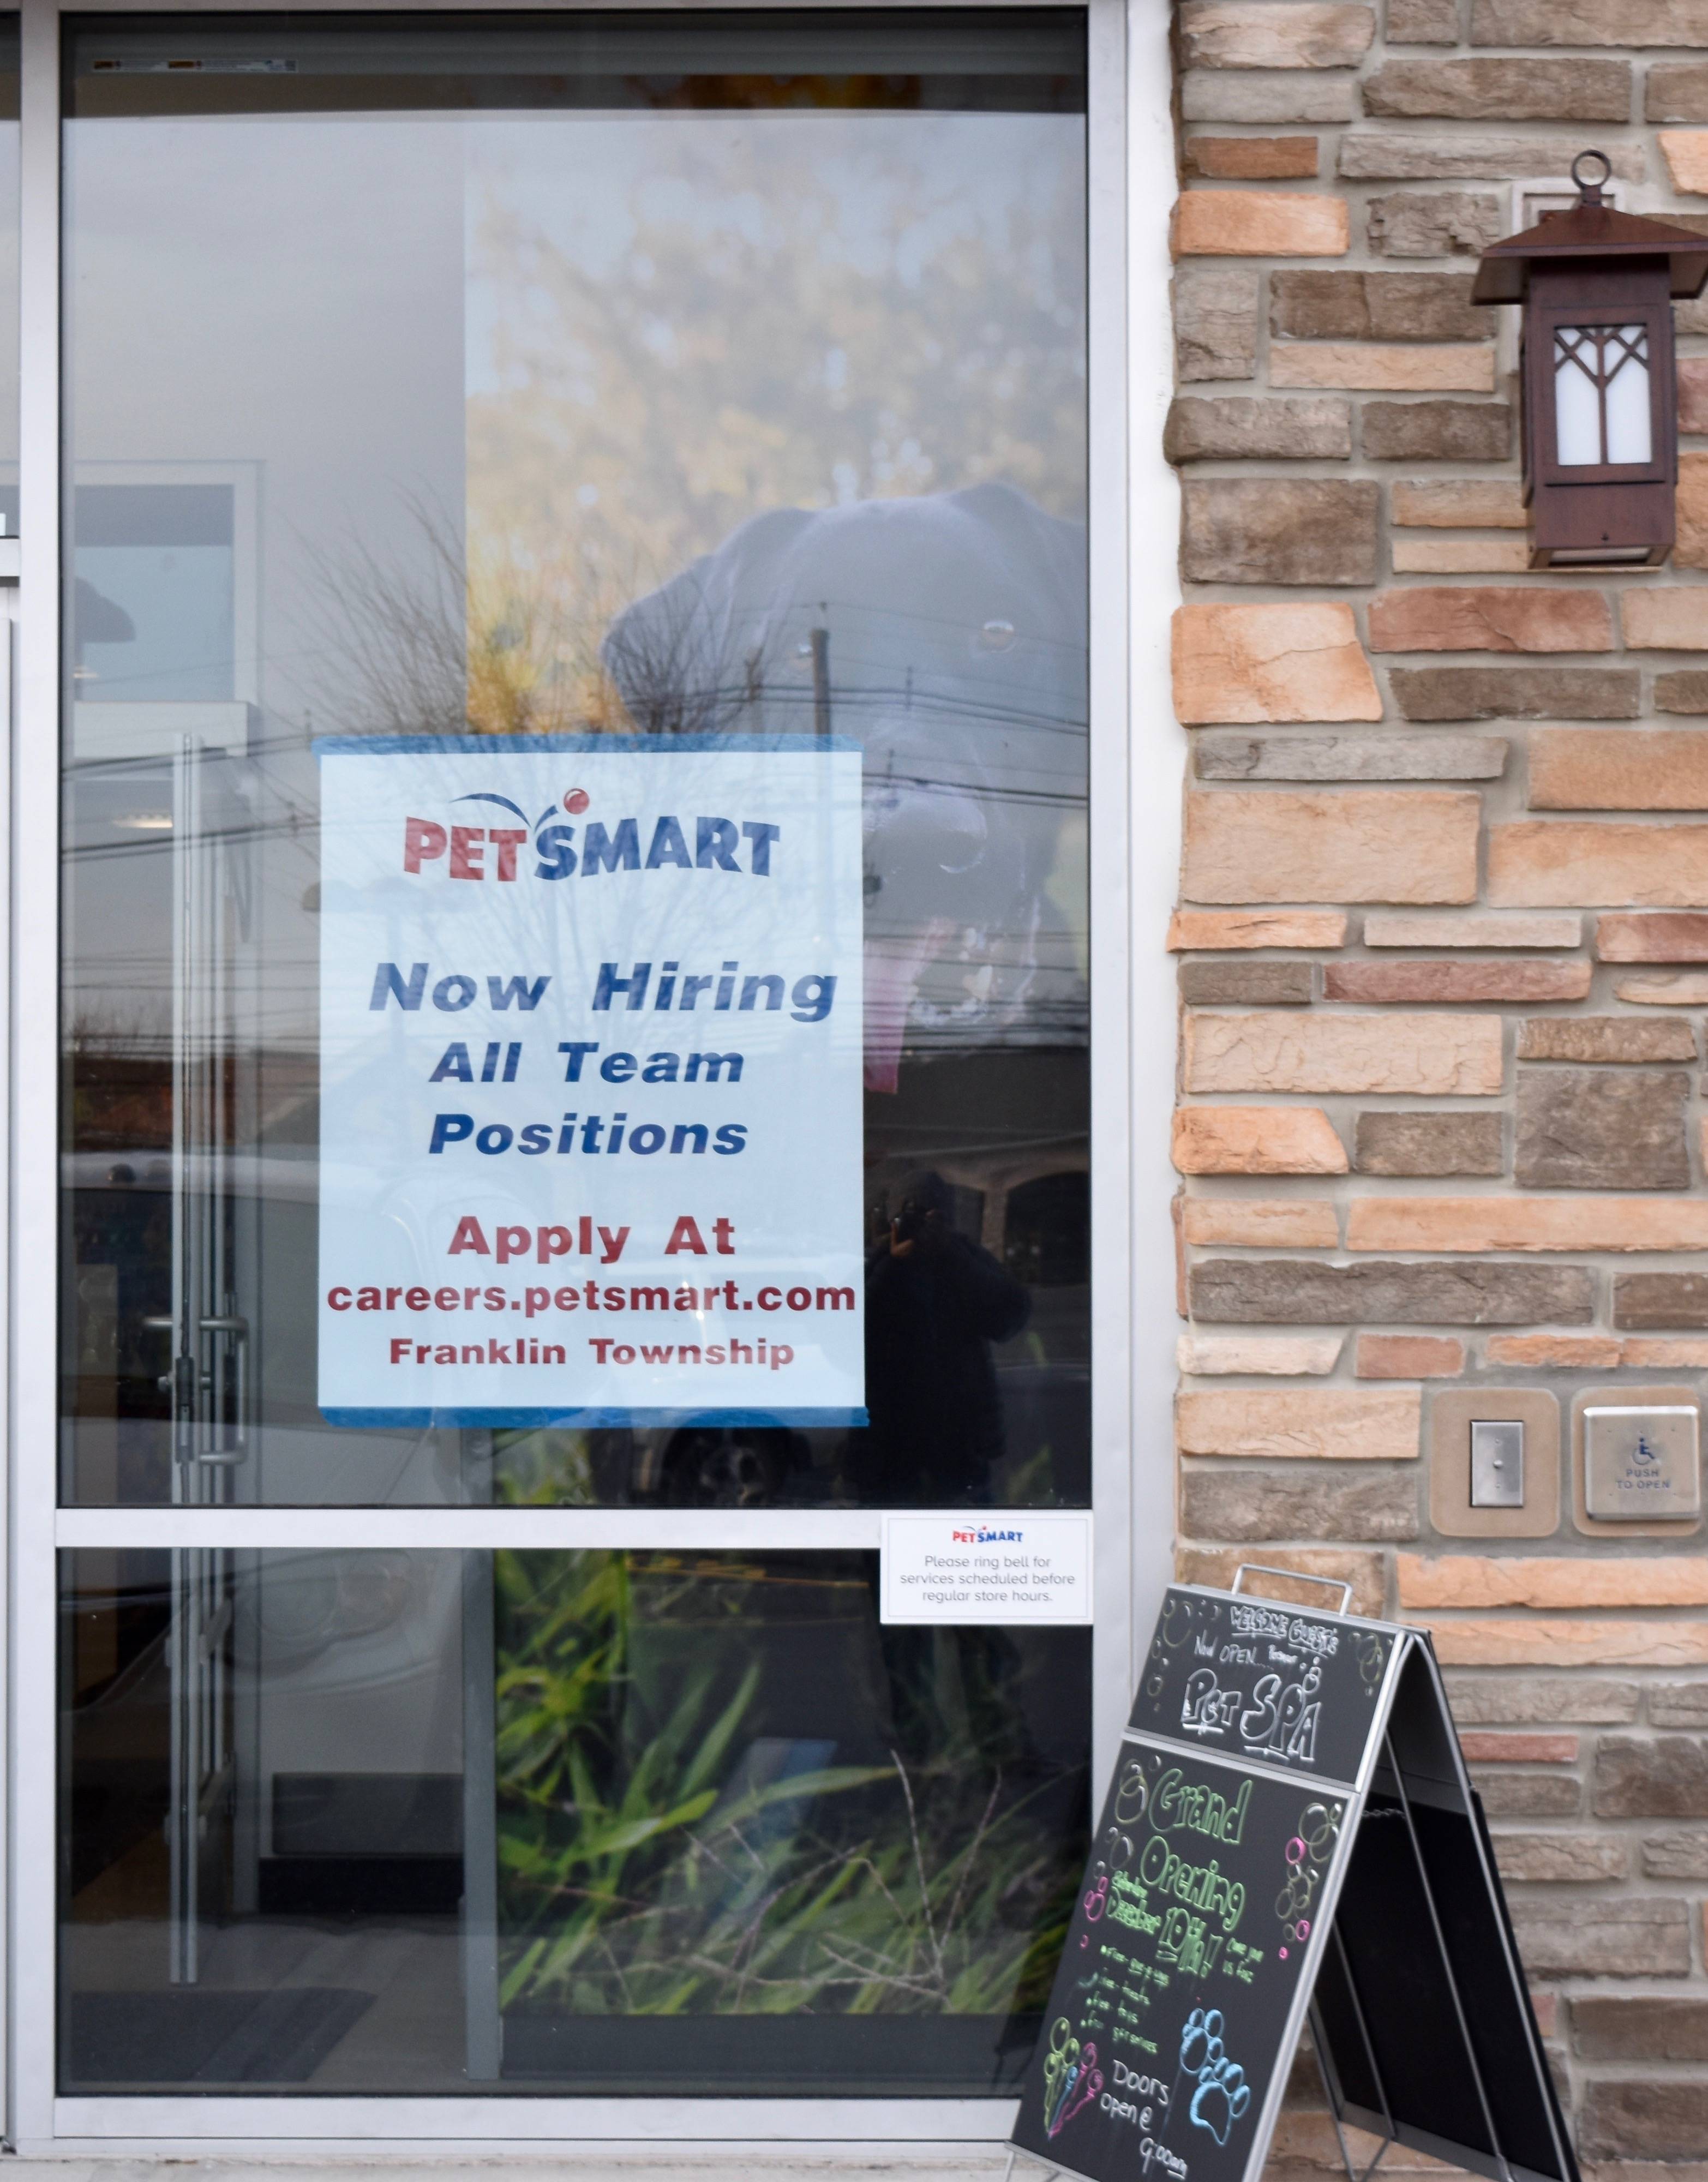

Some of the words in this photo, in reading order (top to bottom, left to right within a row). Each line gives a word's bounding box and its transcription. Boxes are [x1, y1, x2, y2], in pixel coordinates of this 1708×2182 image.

[404, 813, 780, 882] PETSMART
[370, 962, 552, 1012] Now
[591, 961, 838, 1023] Hiring
[428, 1041, 523, 1083] All
[556, 1041, 745, 1084] Team
[428, 1112, 749, 1156] Positions
[446, 1215, 631, 1264] Apply
[664, 1215, 736, 1255] At
[327, 1280, 856, 1319] careers.petsmart.com
[390, 1338, 566, 1366] Franklin
[589, 1338, 795, 1370] Township
[1615, 1480, 1633, 1489] TO
[1637, 1479, 1671, 1489] OPEN
[1626, 1468, 1659, 1478] PUSH
[952, 1529, 1023, 1543] PETSMART
[900, 1573, 954, 1584] services
[958, 1572, 1028, 1584] scheduled
[1032, 1572, 1075, 1584] before
[925, 1555, 969, 1567] Please
[974, 1556, 999, 1570] ring
[1004, 1555, 1028, 1567] bell
[1033, 1555, 1051, 1567] for
[922, 1590, 970, 1603] regular
[975, 1590, 1008, 1601] store
[1012, 1590, 1053, 1601] hours.
[1239, 1673, 1321, 1761] SPA
[1148, 1768, 1253, 1845] Grand
[1112, 2059, 1170, 2106] Doors
